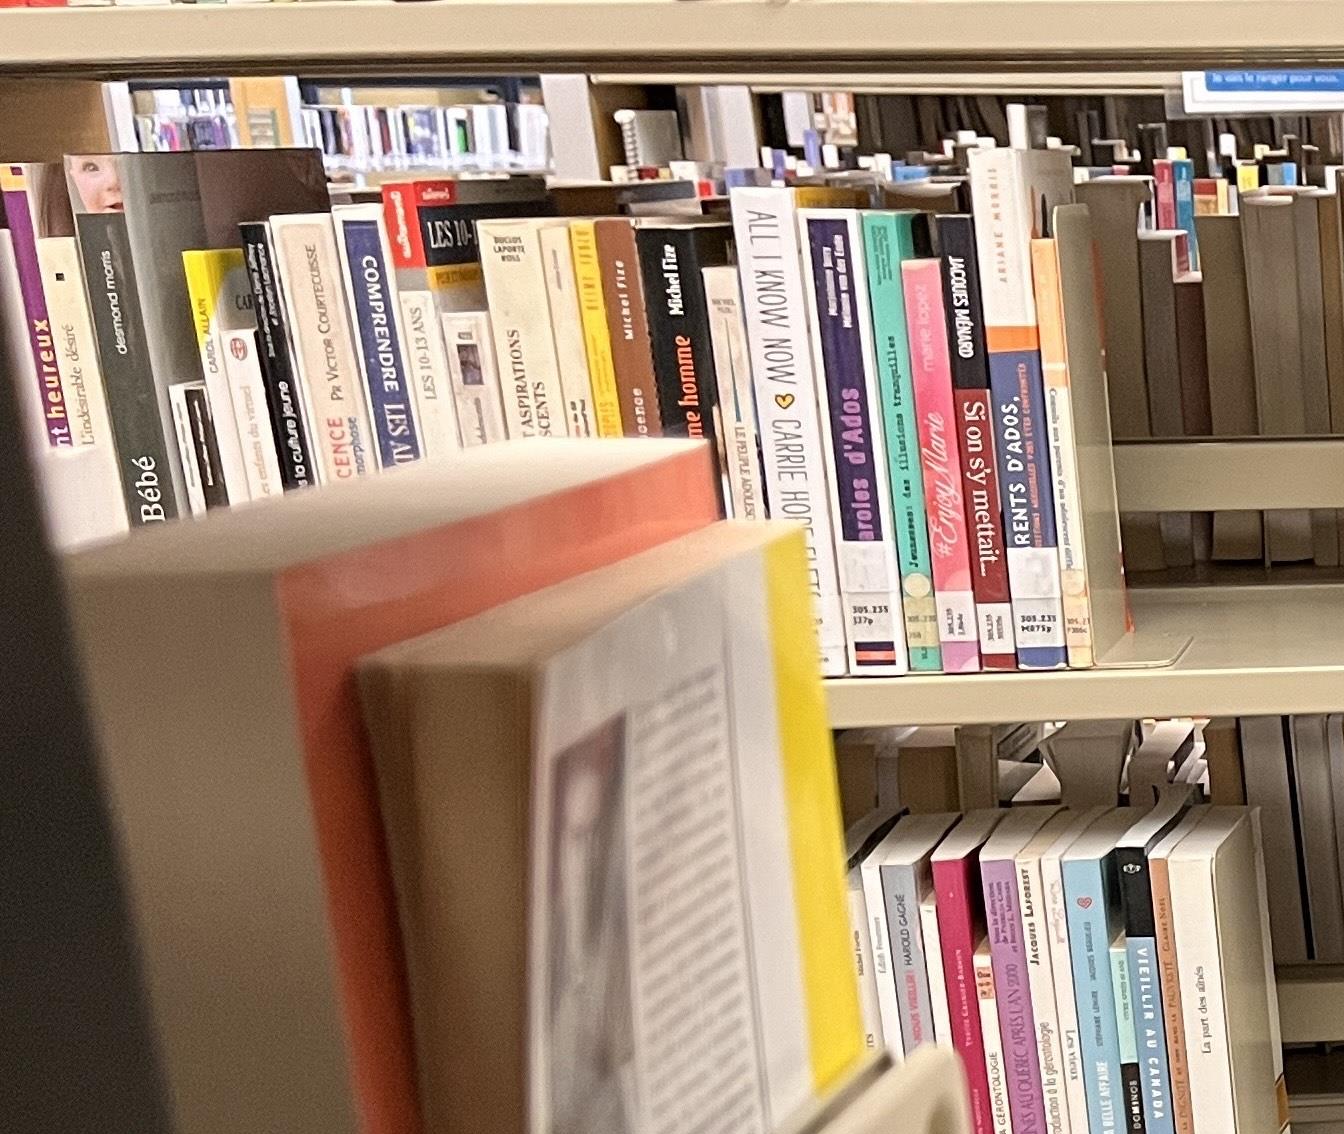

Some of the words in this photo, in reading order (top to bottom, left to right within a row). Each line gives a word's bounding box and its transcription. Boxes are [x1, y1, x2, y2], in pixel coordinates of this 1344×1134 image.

[1256, 75, 1287, 84] ranger
[1289, 75, 1312, 84] pour
[745, 210, 778, 245] ALL
[100, 250, 114, 290] morris
[662, 244, 678, 270] Fize
[663, 273, 685, 316] Michel
[755, 269, 791, 328] KNOW
[948, 256, 970, 307] JACQUES
[104, 292, 129, 354] desmond
[362, 255, 399, 393] COMPRENDRE
[619, 293, 634, 340] Michel
[952, 309, 975, 358] MÉNARD
[61, 324, 79, 362] désiré
[415, 336, 432, 375] 10-13
[763, 337, 798, 385] NOW
[32, 319, 65, 419] heureux
[507, 329, 533, 429] ASPIRATIONS
[674, 335, 699, 406] homme
[963, 401, 986, 424] Si
[771, 418, 808, 484] CARRIE
[964, 426, 983, 452] on
[132, 456, 165, 522] Bébé
[894, 894, 907, 926] GAGNÉ
[900, 928, 913, 966] HAROLD
[1136, 947, 1155, 1020] VIEILLIR
[1193, 966, 1208, 993] aînés
[1197, 996, 1208, 1014] des
[1066, 1028, 1080, 1050] Les
[1146, 1028, 1159, 1048] AU
[1200, 1016, 1214, 1039] part
[1200, 1040, 1213, 1054] La
[1067, 1053, 1081, 1081] vieux
[1096, 1061, 1113, 1098] AFFAIRE
[988, 1052, 1007, 1126] GÉRONTOLOGIE
[1128, 1079, 1143, 1130] DOMINOS
[1148, 1057, 1165, 1119] CANADA
[1101, 1100, 1115, 1127] BELLE
